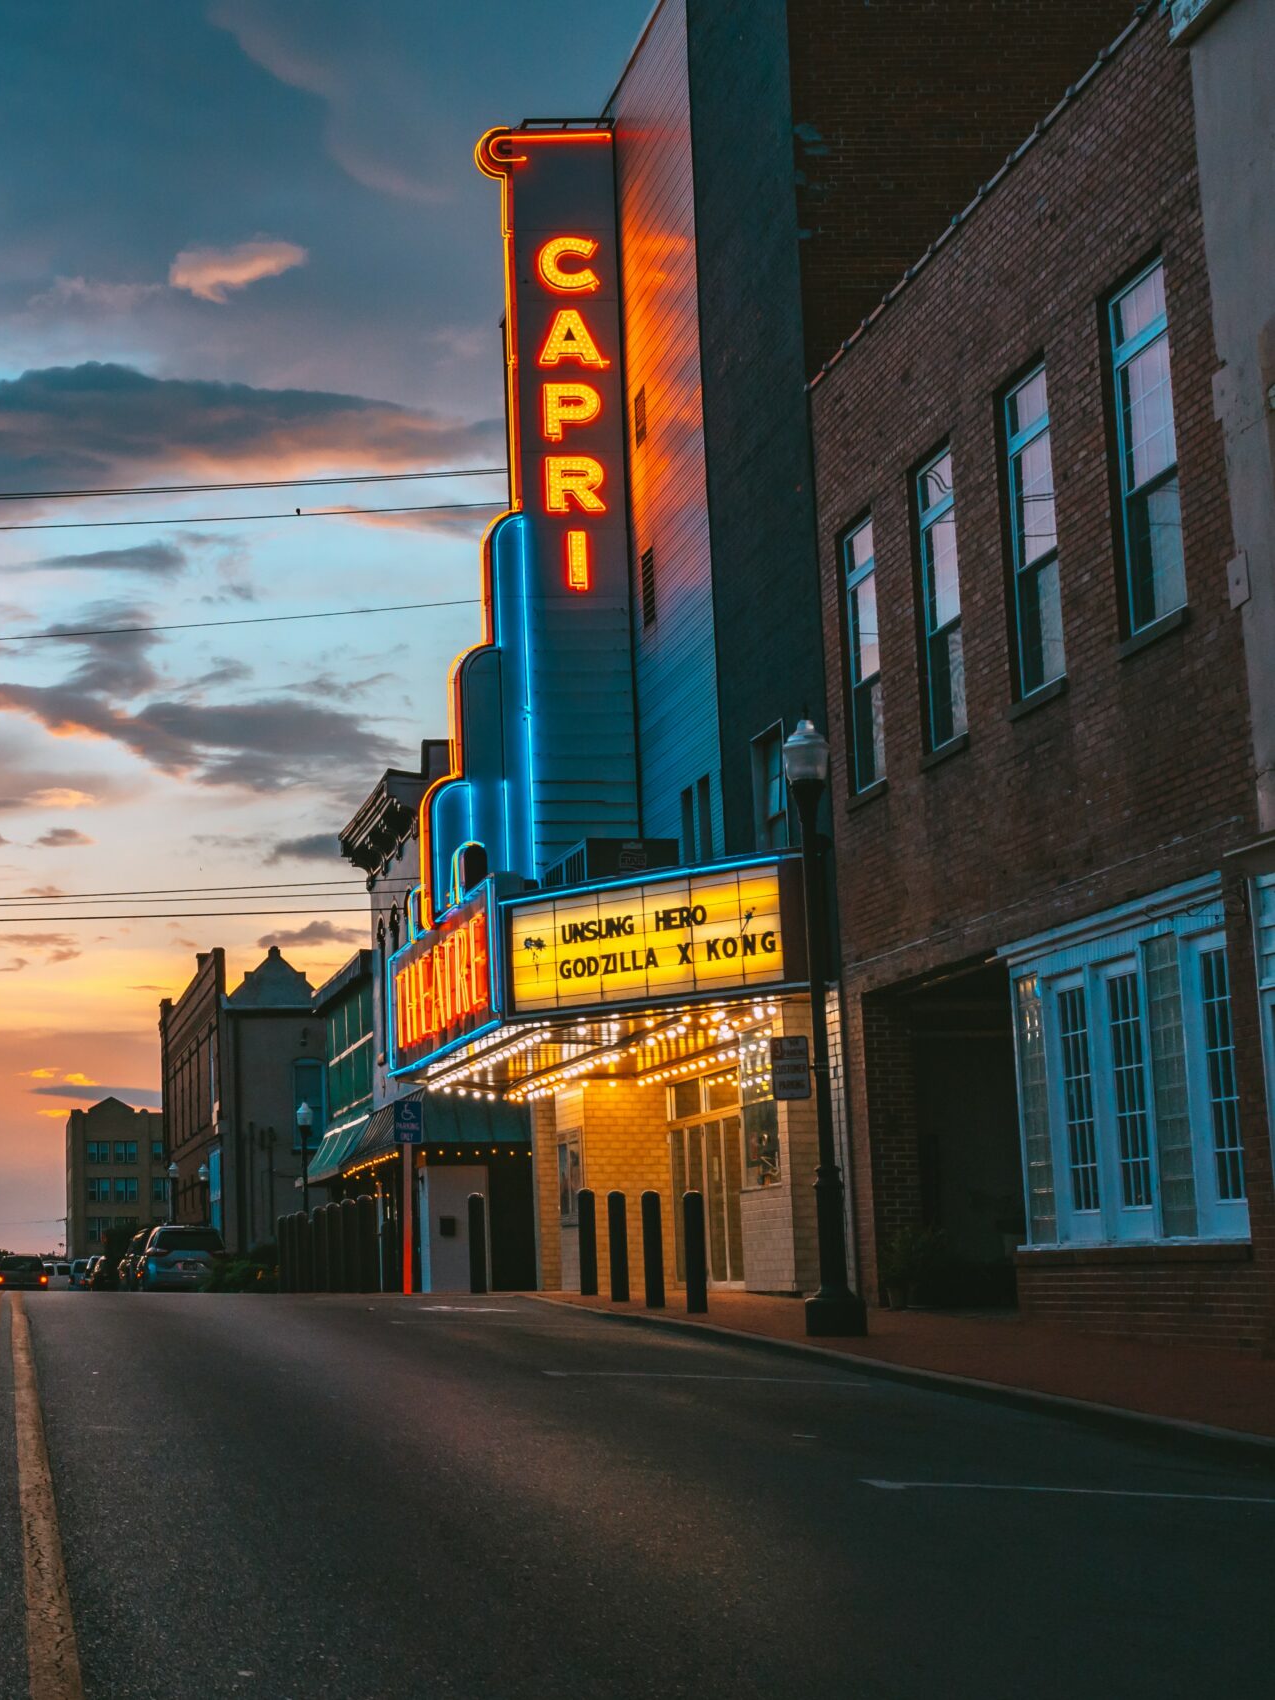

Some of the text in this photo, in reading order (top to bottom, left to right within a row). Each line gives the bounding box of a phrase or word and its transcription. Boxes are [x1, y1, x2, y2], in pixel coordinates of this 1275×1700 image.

[539, 237, 607, 590] CAPRI
[561, 905, 707, 945] UNSUNG HERO
[559, 931, 776, 979] GODZILLA X KONG
[395, 913, 487, 1048] THEATRE
[775, 1064, 807, 1074] CUSTOMER
[778, 1080, 806, 1091] PARKING
[395, 1122, 420, 1131] PARKING
